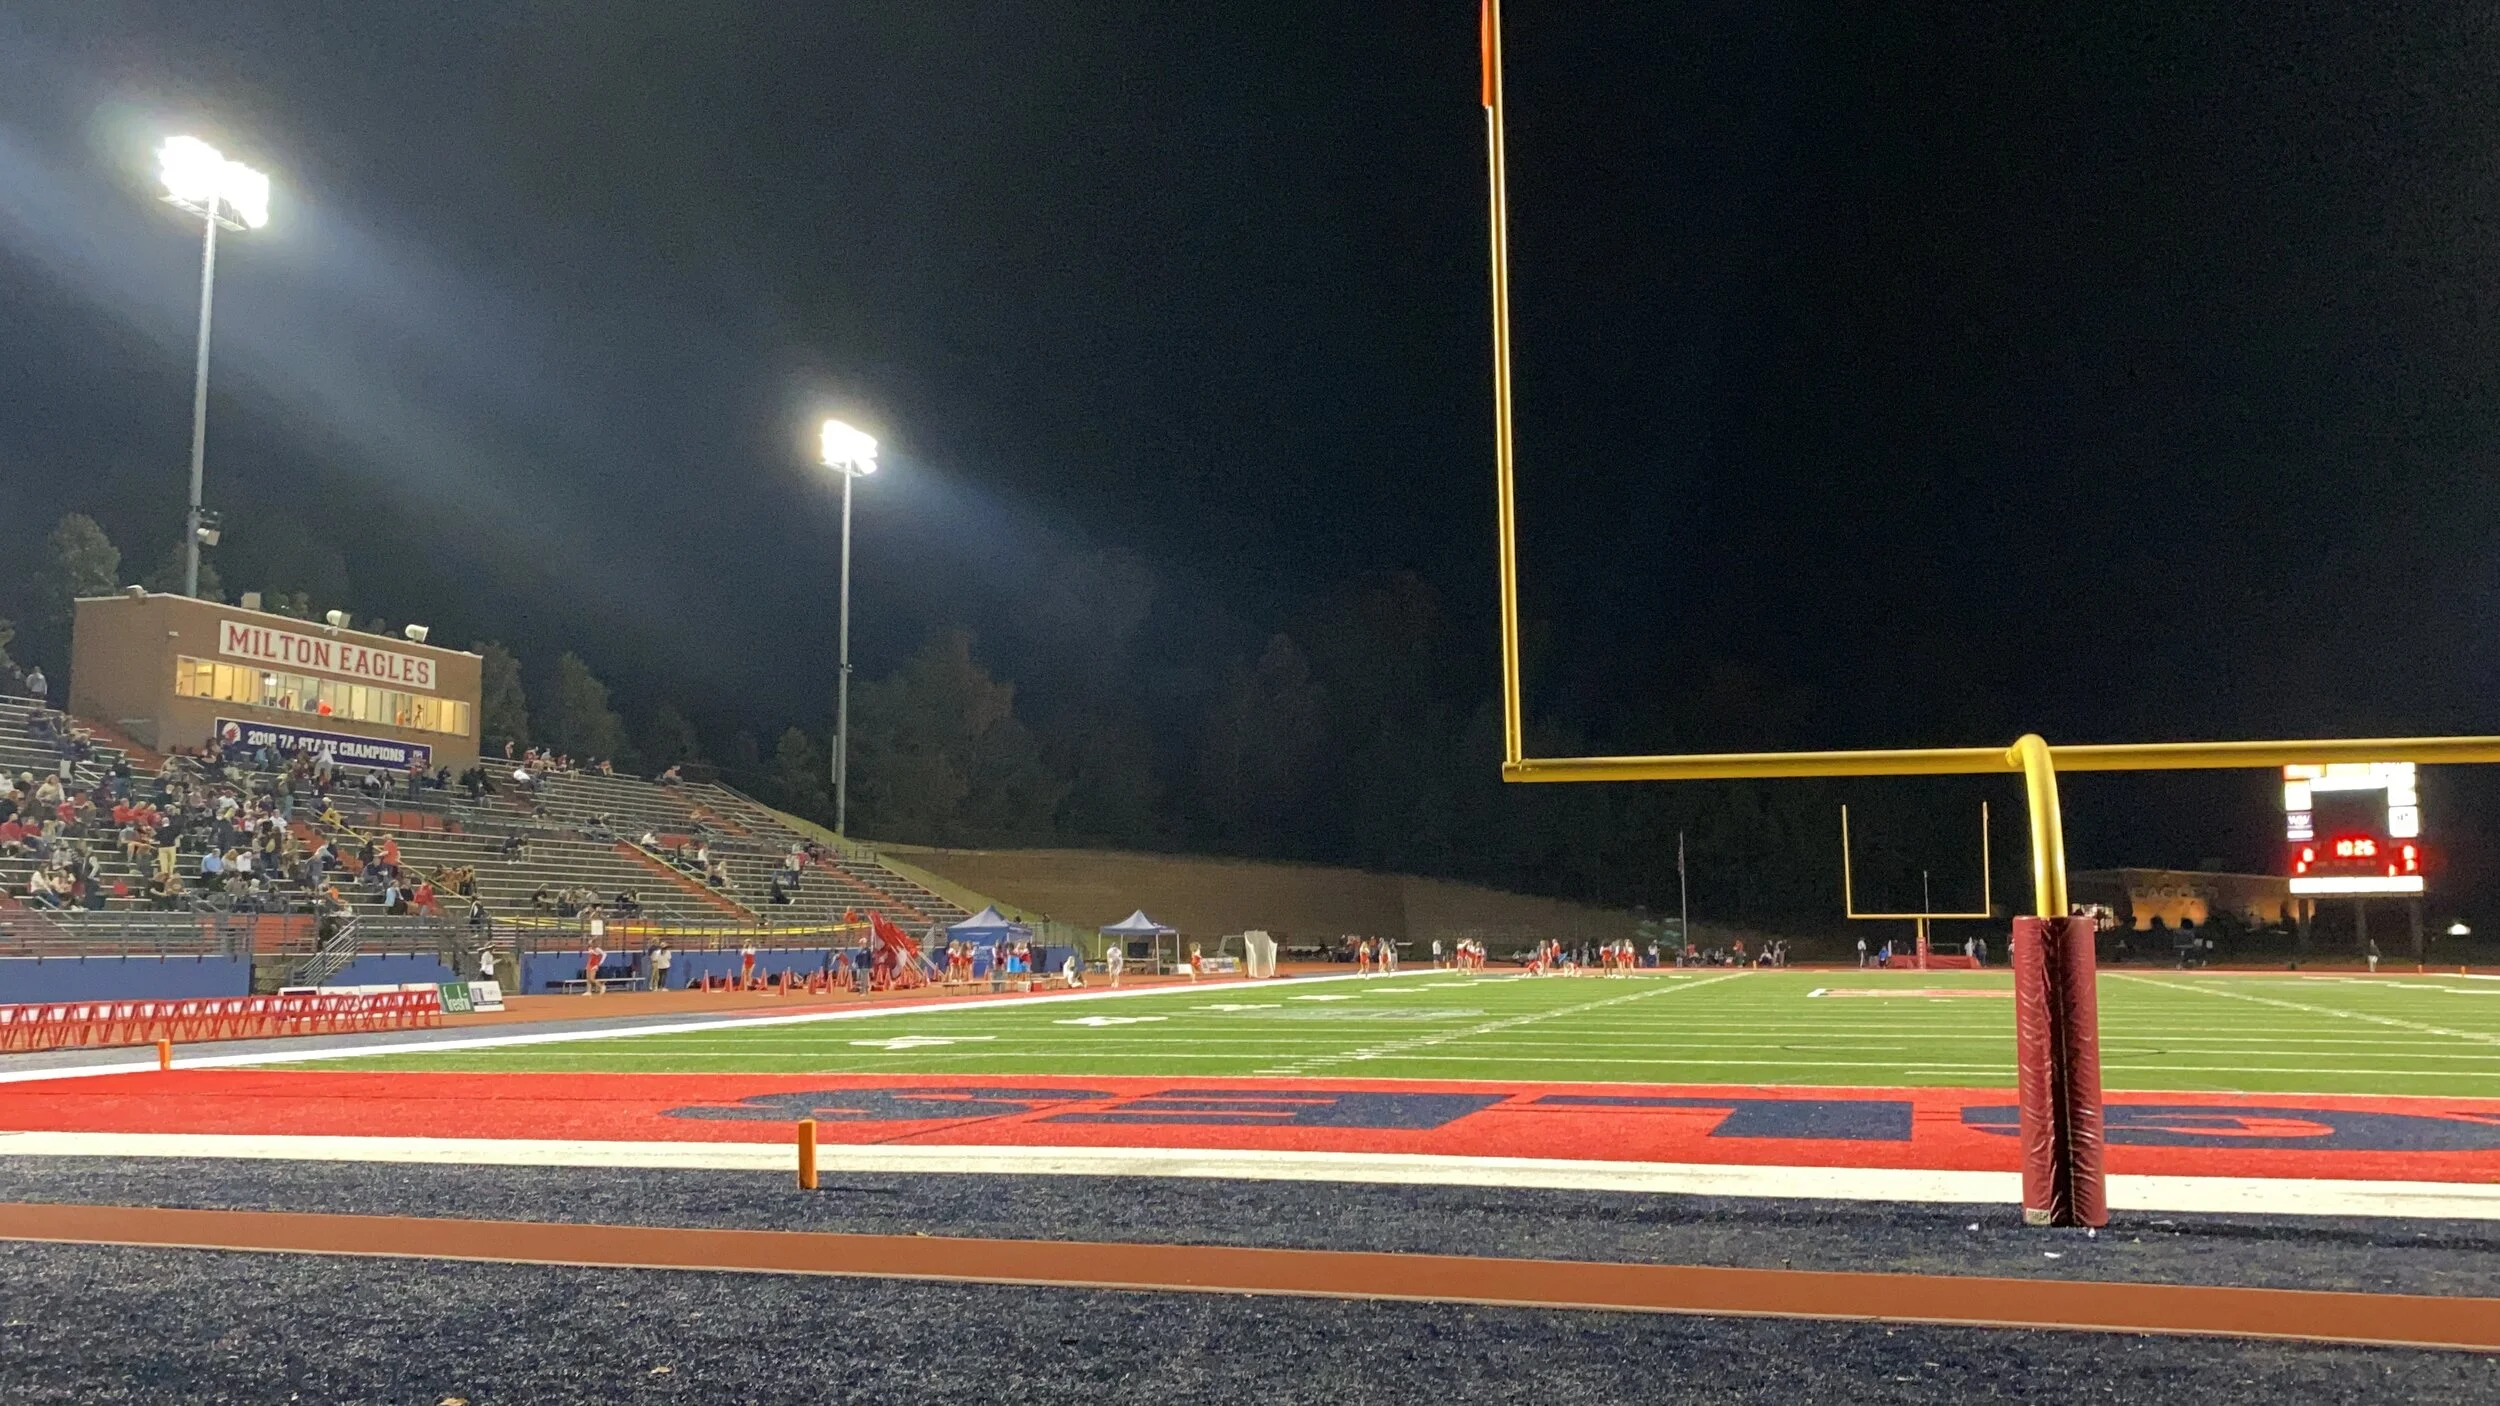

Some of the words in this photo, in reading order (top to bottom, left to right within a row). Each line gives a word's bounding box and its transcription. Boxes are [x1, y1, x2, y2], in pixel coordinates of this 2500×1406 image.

[228, 625, 331, 667] MILTON
[340, 646, 430, 684] EAGLES
[339, 741, 406, 762] CHAMPIONS
